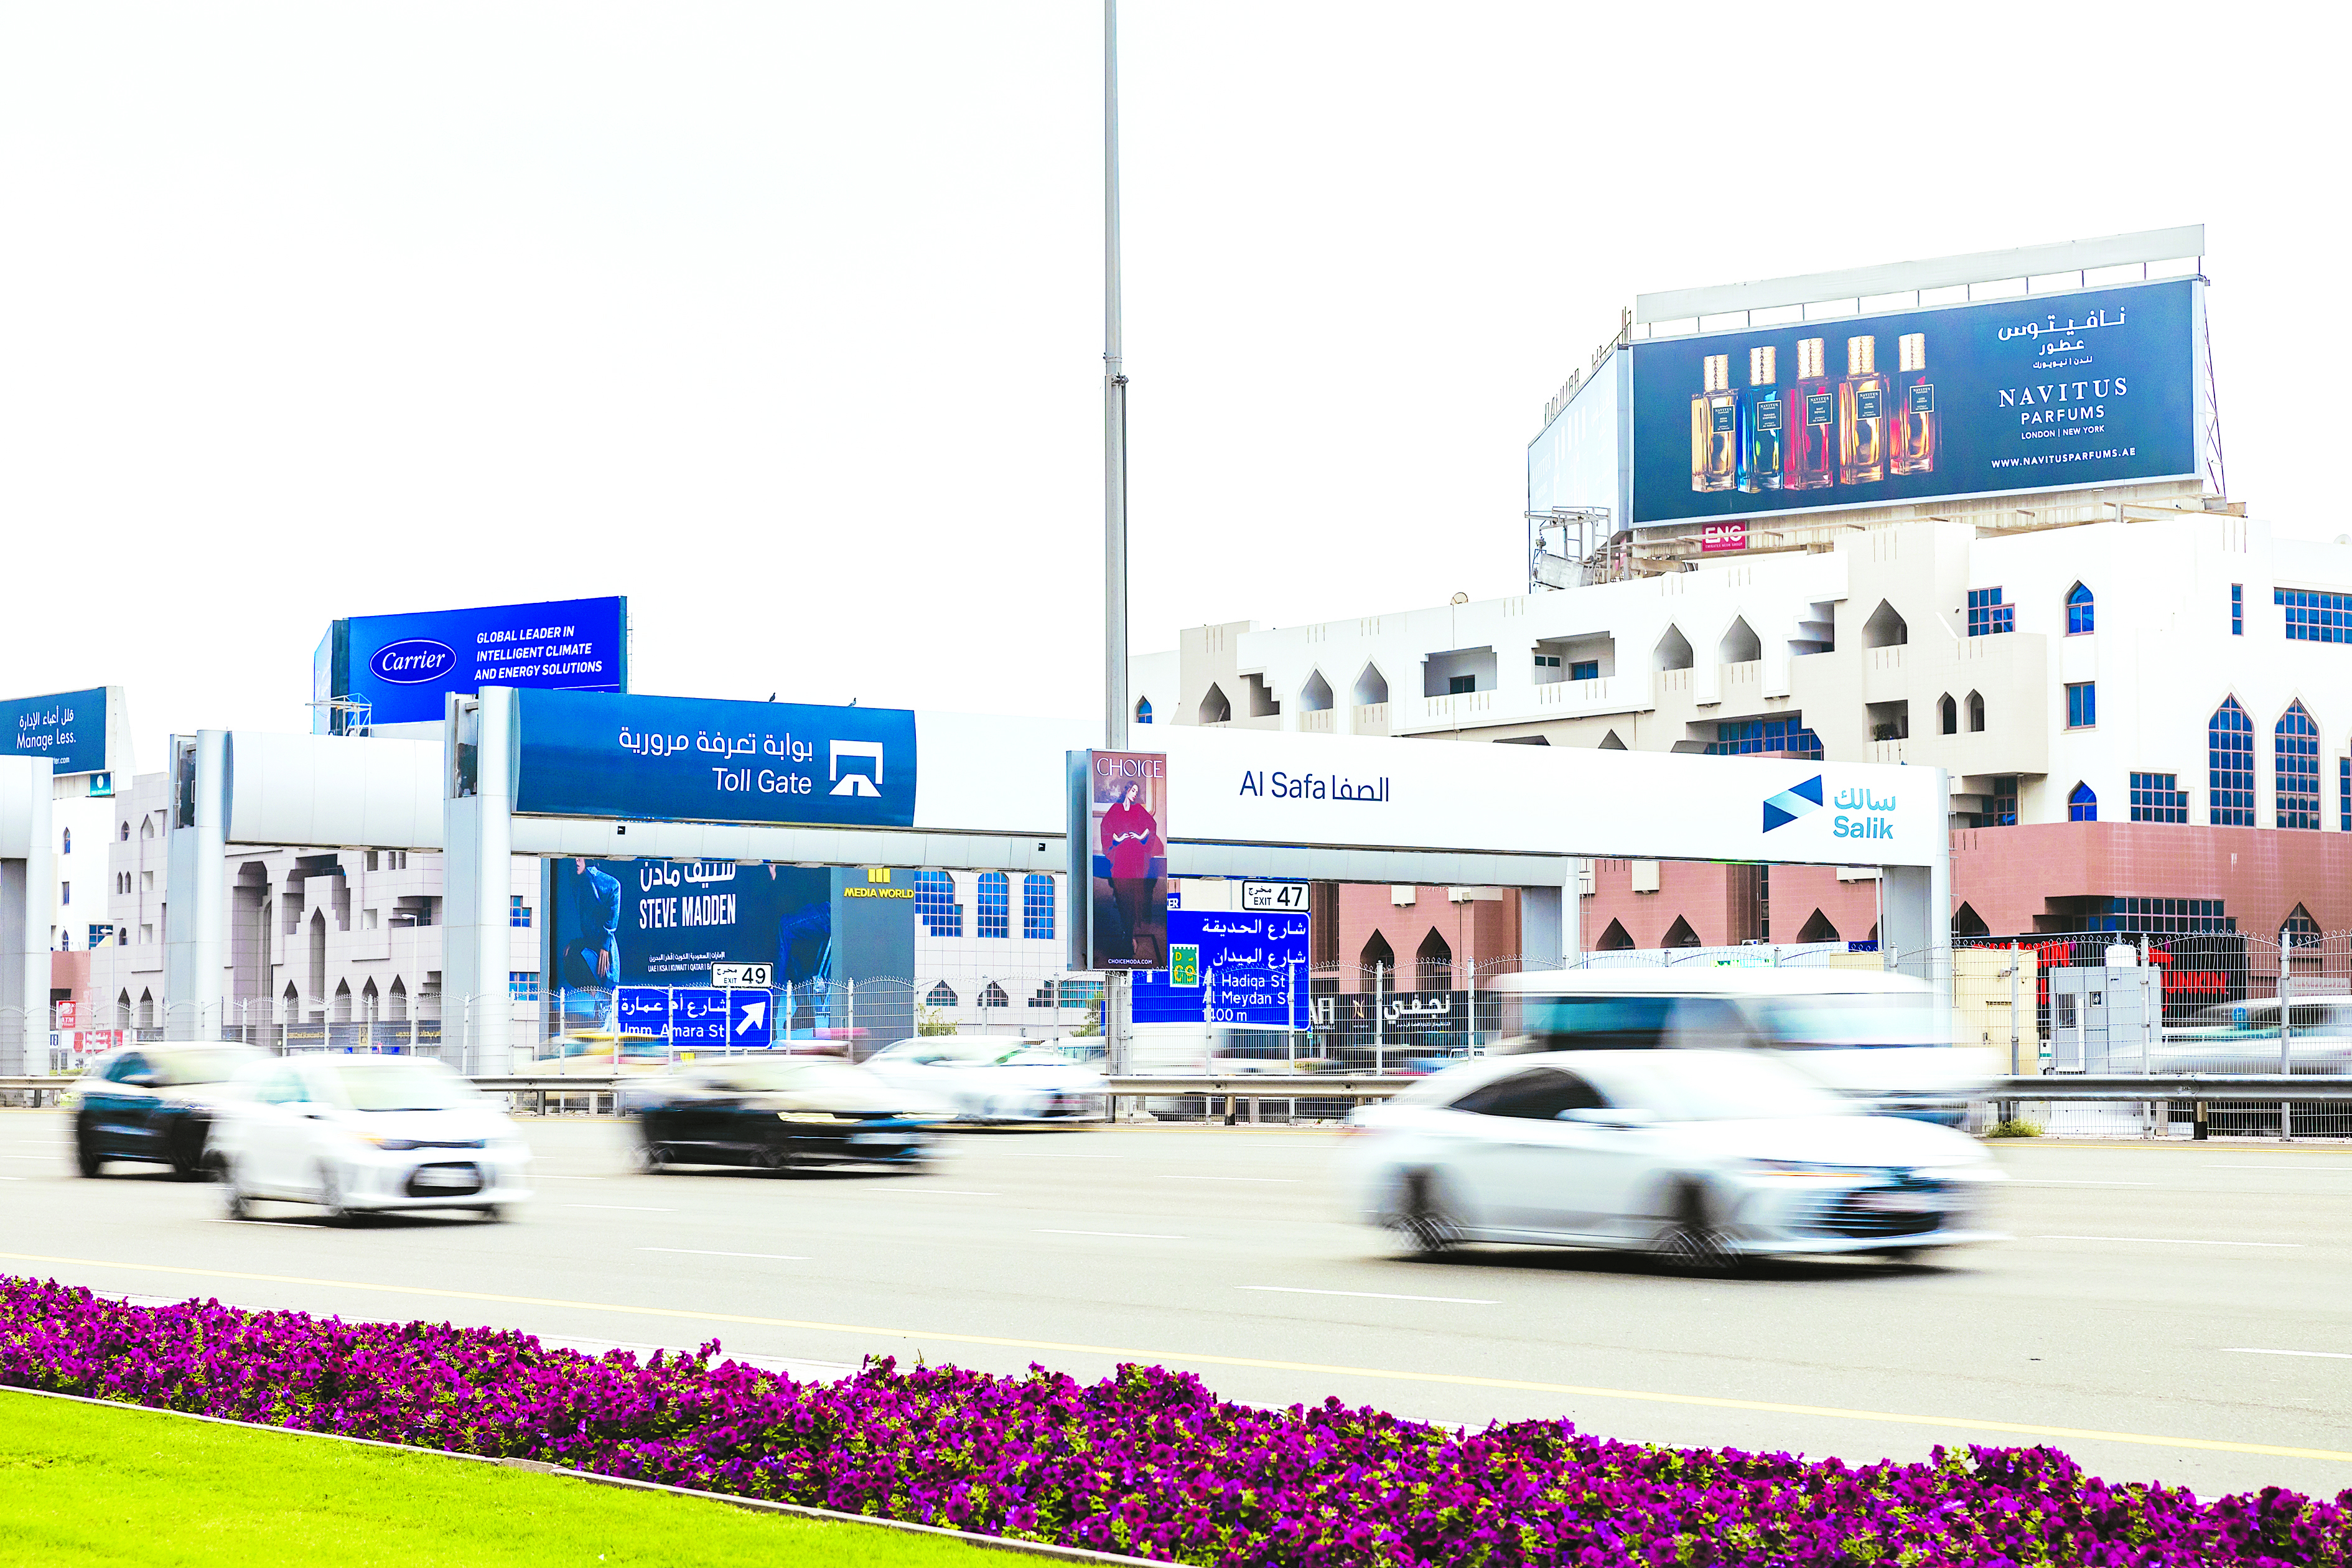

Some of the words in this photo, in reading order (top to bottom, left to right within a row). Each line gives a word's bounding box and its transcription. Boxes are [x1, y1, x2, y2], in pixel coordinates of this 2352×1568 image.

[1997, 306, 2126, 340] نافيتوس
[2038, 339, 2084, 355] عطور
[1999, 377, 2127, 408] NAVITUS
[2021, 405, 2104, 425] PARFUMS
[2021, 429, 2055, 440] LONDON
[2063, 427, 2081, 436] NEW
[2083, 425, 2104, 434] YORK
[1991, 447, 2135, 468] WWW.NAVITUSPARFUMS.AE
[477, 630, 518, 643] GLOBAL
[520, 627, 561, 641] LEADER
[563, 625, 575, 637] IN
[383, 651, 446, 671] Carrier
[477, 646, 544, 661] INTELLIGENT
[545, 643, 592, 657] CLIMATE
[474, 667, 497, 681] AND
[498, 665, 541, 679] ENERGY
[542, 660, 602, 675] SOLUTIONS
[17, 732, 53, 751] Manage
[57, 728, 76, 744] Less.
[618, 726, 689, 757] مرورية
[696, 730, 756, 759] تعرفة
[763, 732, 813, 762] بوابة
[1096, 757, 1164, 778] CHOICE
[712, 767, 750, 791] Toll
[758, 769, 812, 795] Gate
[1239, 770, 1263, 796] Al
[1271, 772, 1325, 799] Safa
[1332, 775, 1389, 802] الصفا
[1834, 788, 1896, 811] سالك
[1833, 815, 1893, 839] Salik
[640, 861, 680, 892] مادن
[844, 887, 877, 898] MEDIA
[878, 888, 915, 898] WORLD
[1248, 886, 1272, 895] مخرج
[1254, 897, 1272, 905] EXIT
[1277, 887, 1302, 907] 47
[639, 897, 677, 929] STEVE
[682, 894, 735, 926] MADDEN
[1202, 918, 1262, 937] الحديقة
[1267, 920, 1305, 940] شارع
[1175, 952, 1182, 961] D
[1213, 947, 1262, 966] الميدان
[1267, 948, 1305, 969] شارع
[717, 967, 737, 975] مخرج
[742, 968, 765, 984] 49
[1222, 974, 1265, 990] Hadiqa
[1271, 974, 1285, 987] St
[621, 996, 663, 1015] عمارة
[687, 997, 726, 1018] شارع
[1222, 991, 1272, 1007] Meydan
[1202, 1008, 1233, 1021] 1400
[1237, 1012, 1247, 1021] m
[661, 1024, 704, 1037] Amara
[709, 1024, 724, 1037] St
